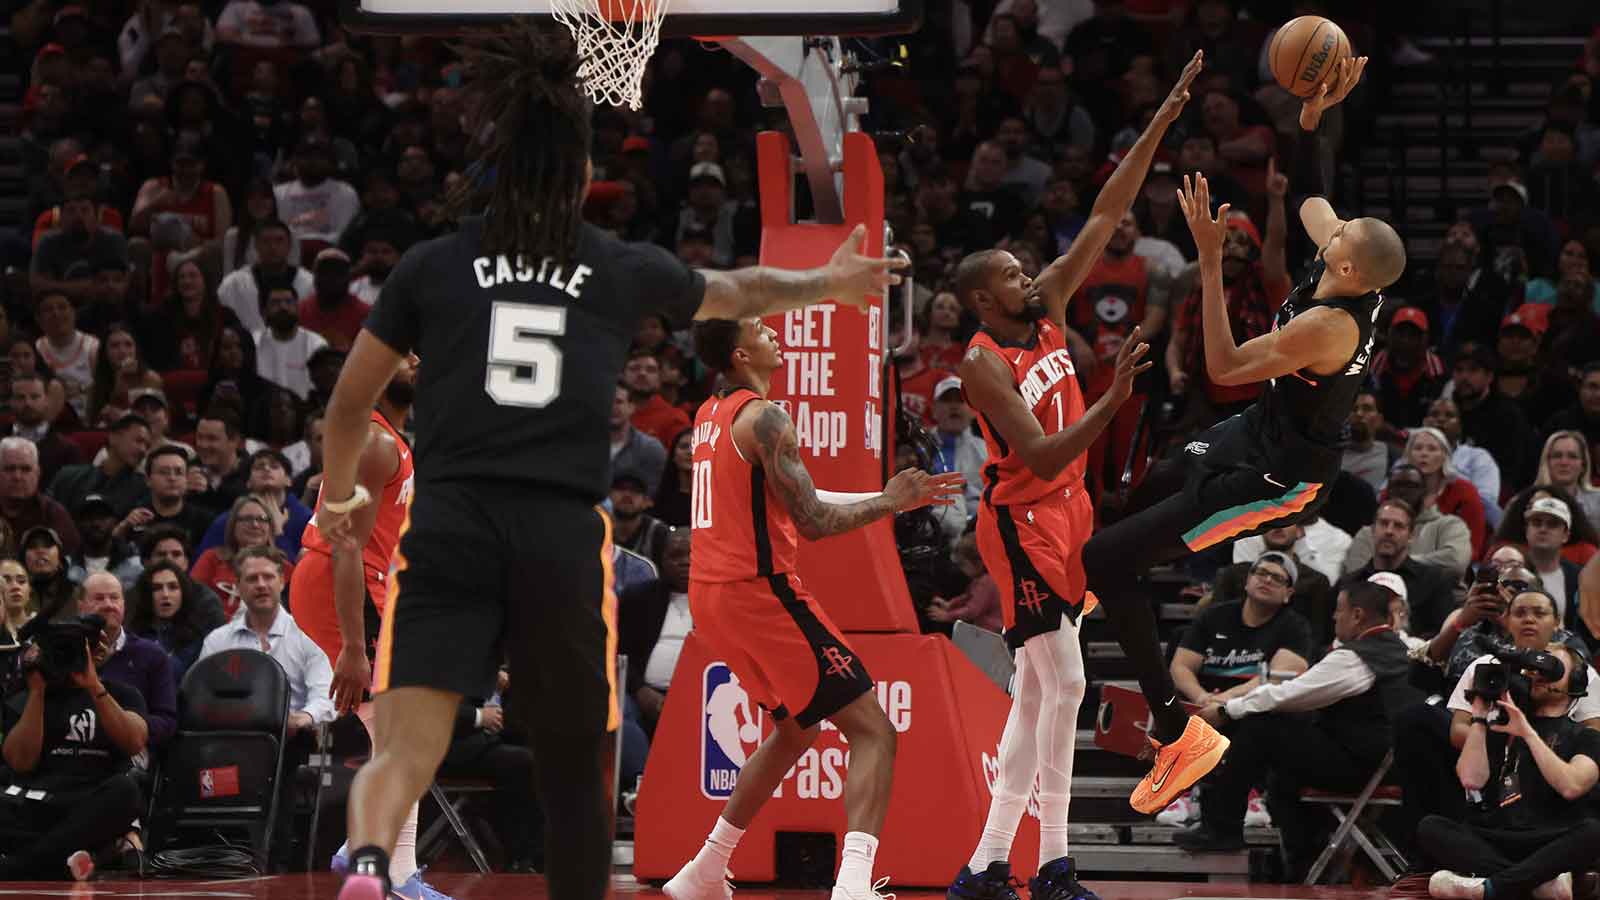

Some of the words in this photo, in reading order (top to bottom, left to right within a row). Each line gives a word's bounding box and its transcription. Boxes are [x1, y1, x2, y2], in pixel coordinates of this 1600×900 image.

[1302, 33, 1336, 80] Wilson
[473, 254, 592, 298] CASTLE
[784, 304, 836, 347] GET
[485, 301, 567, 408] 5
[783, 352, 836, 396] THE
[796, 401, 847, 457] App
[1051, 391, 1063, 432] 1
[691, 460, 713, 529] 10
[710, 768, 737, 791] NBA
[771, 747, 850, 800] as
